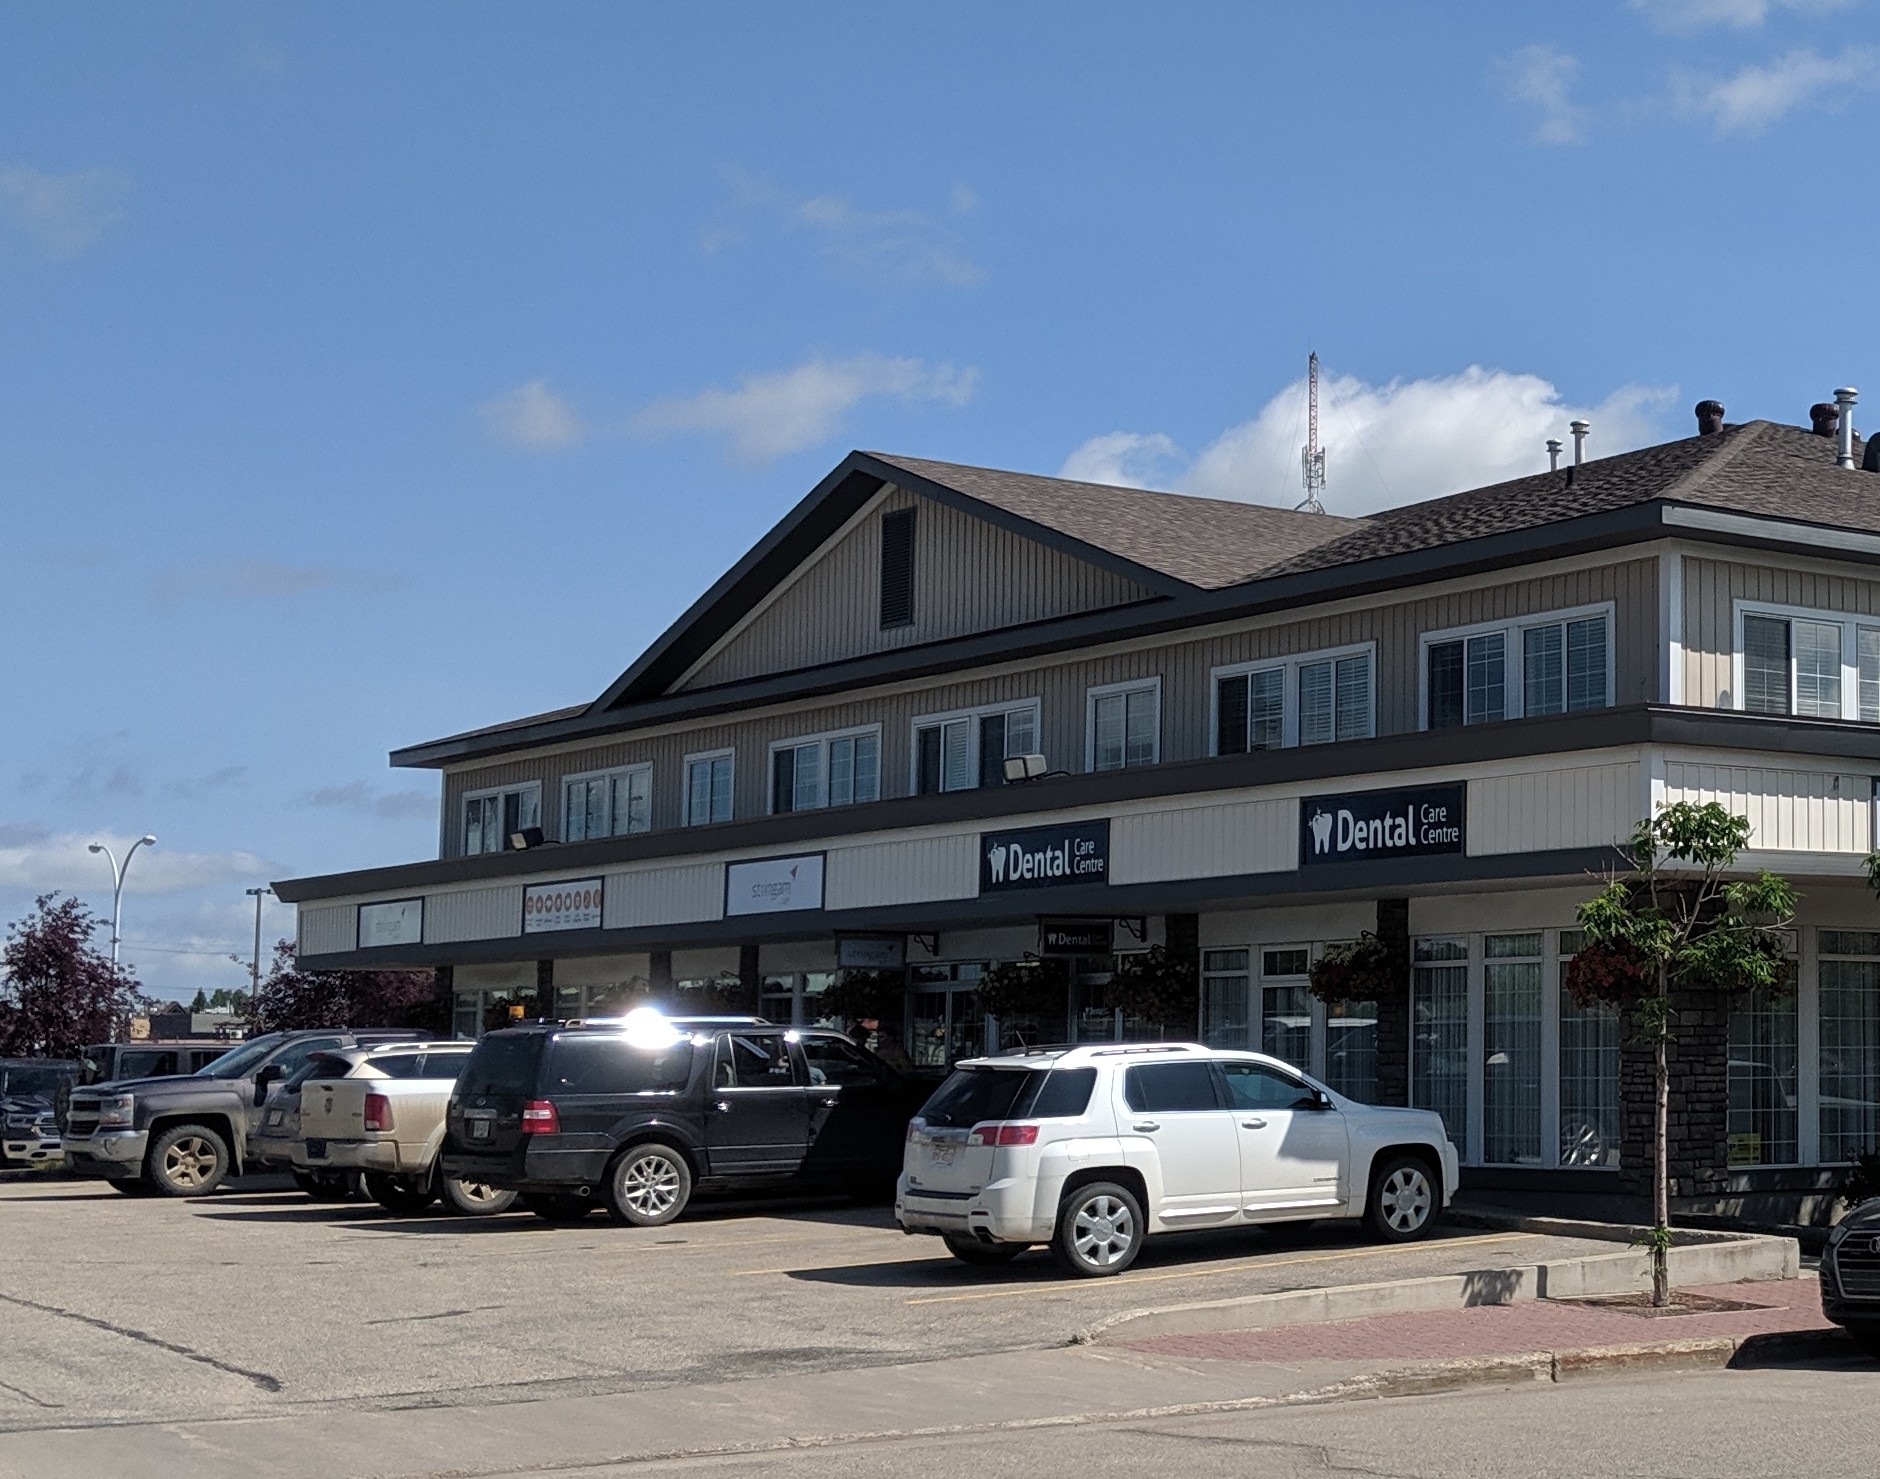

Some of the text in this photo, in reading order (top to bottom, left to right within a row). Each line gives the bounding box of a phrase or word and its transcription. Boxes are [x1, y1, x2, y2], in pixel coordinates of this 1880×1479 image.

[1420, 803, 1447, 823] Care
[1336, 804, 1417, 852] Dental
[1420, 824, 1459, 845] Centre
[1074, 838, 1095, 856] Care
[1009, 839, 1071, 881] Dental
[1073, 856, 1105, 874] Centre
[1058, 932, 1092, 945] Dental
